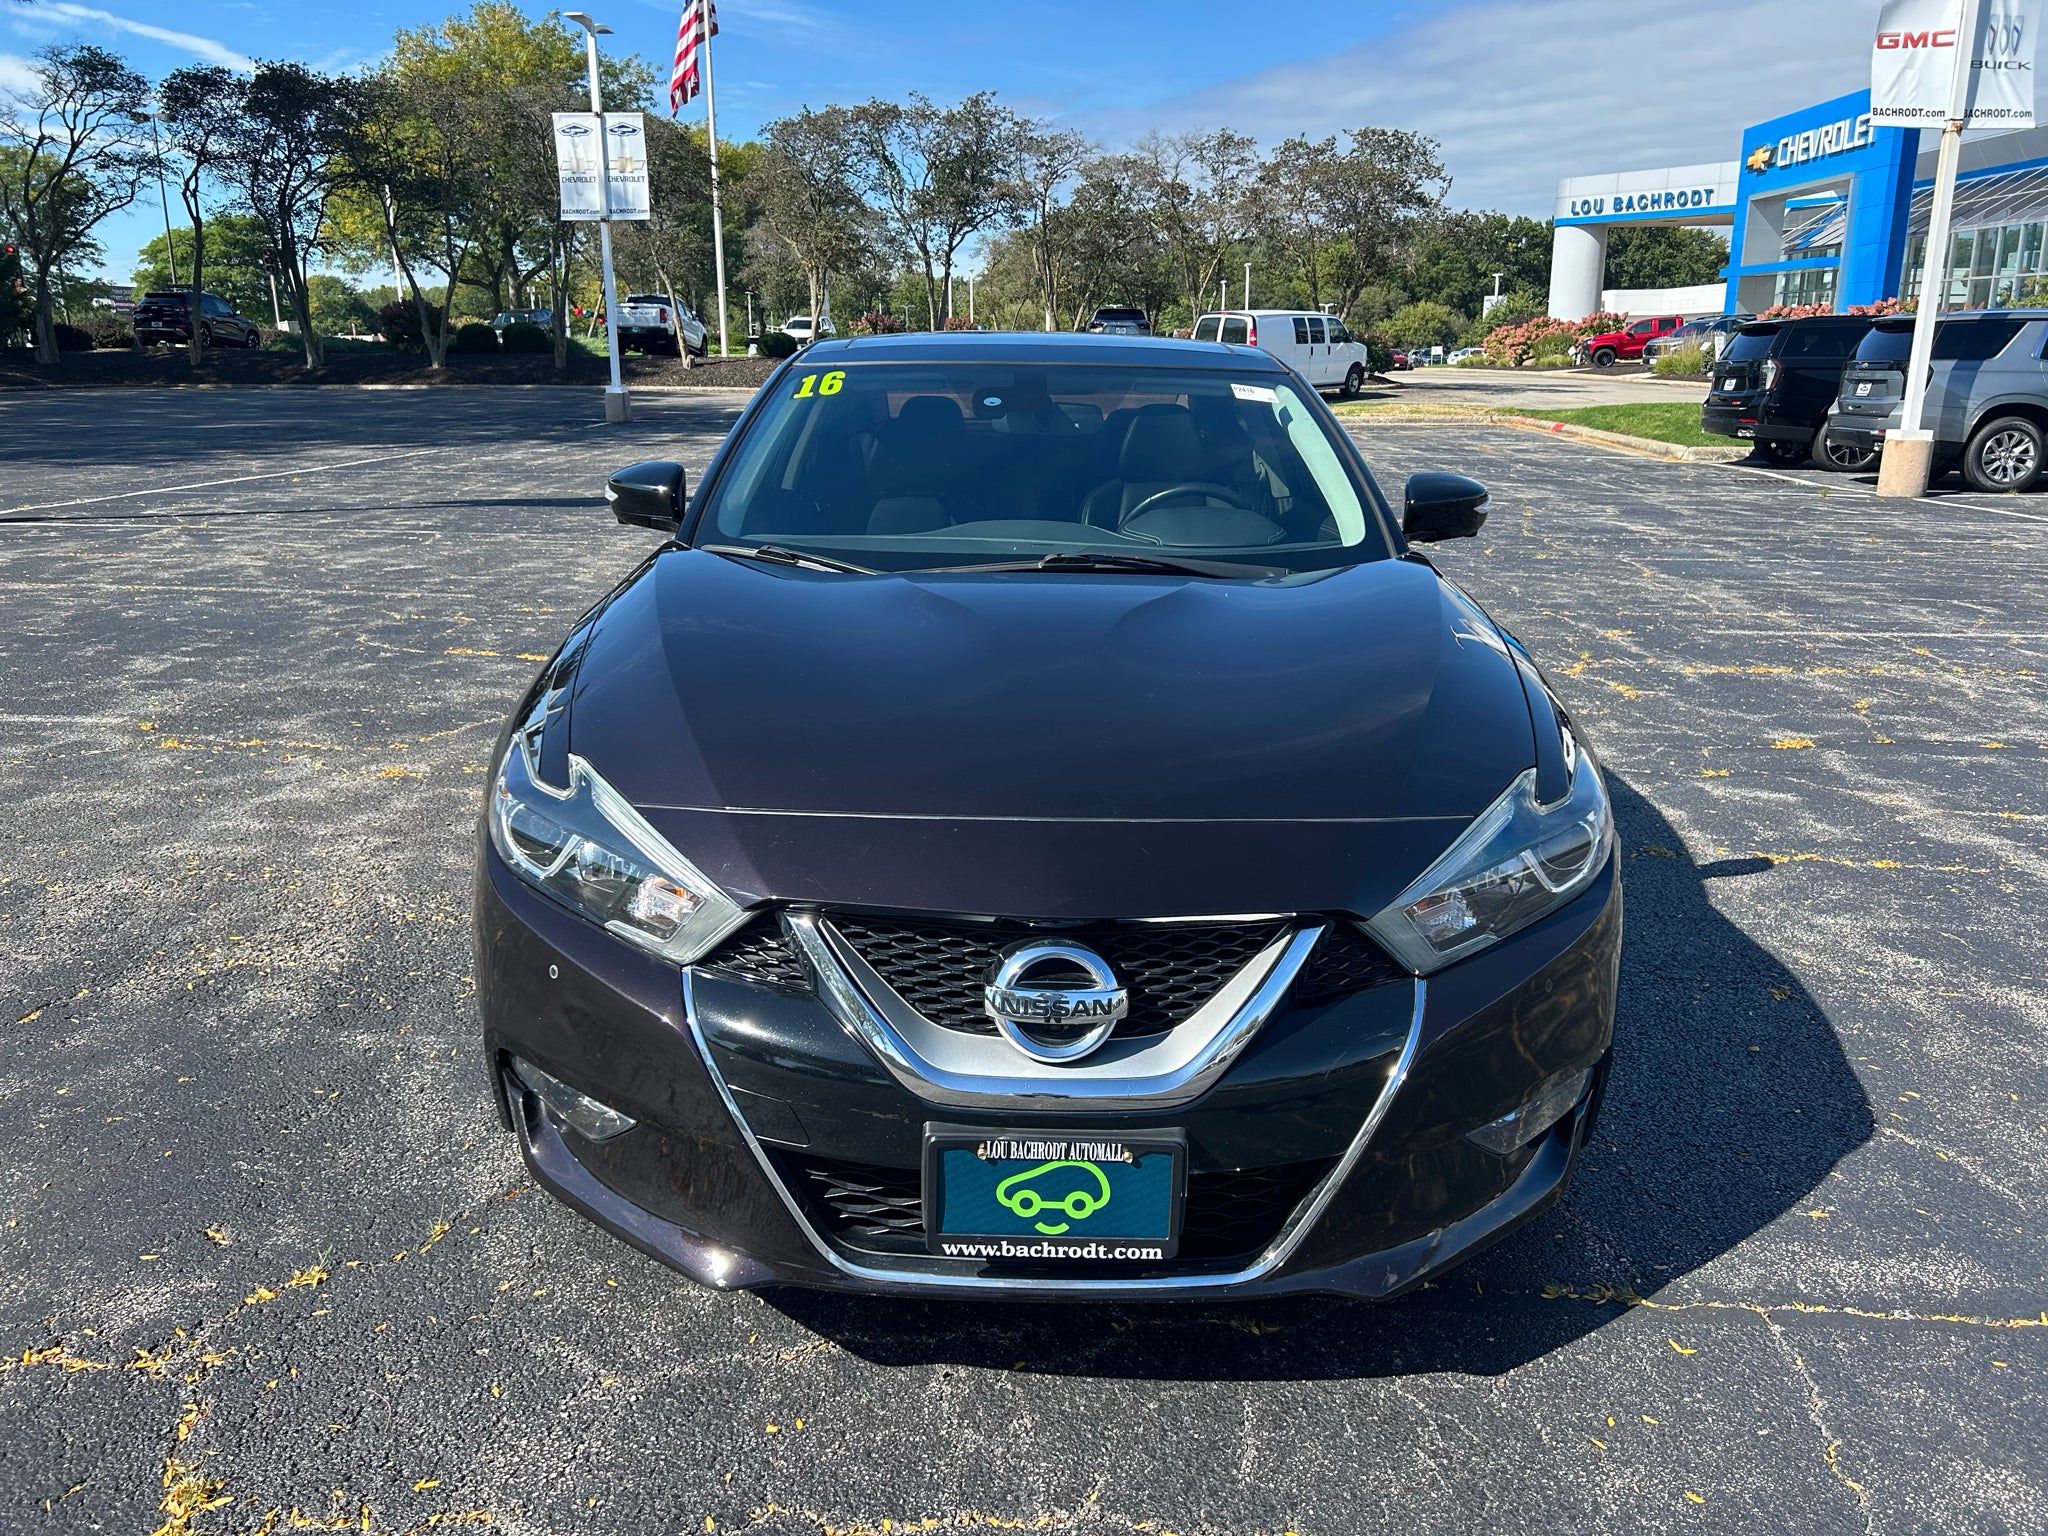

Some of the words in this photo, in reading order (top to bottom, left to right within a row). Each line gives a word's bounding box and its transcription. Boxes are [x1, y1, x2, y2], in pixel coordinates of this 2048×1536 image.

[1876, 29, 1956, 50] GMC
[1971, 60, 2033, 71] BUICK
[1872, 107, 1946, 118] BACHRODT.com
[1963, 108, 2033, 118] BACHRODT.com
[607, 175, 646, 183] CHEVROLET
[1571, 196, 1605, 217] LOU
[1613, 188, 1715, 213] BACHRODT
[793, 371, 846, 398] 16
[1000, 997, 1113, 1017] NISSAN
[986, 1140, 1009, 1160] LOU
[1010, 1141, 1068, 1161] BACHRODT
[1068, 1142, 1124, 1162] AUTOMALL
[941, 1240, 1163, 1260] www.bachrodt.com
